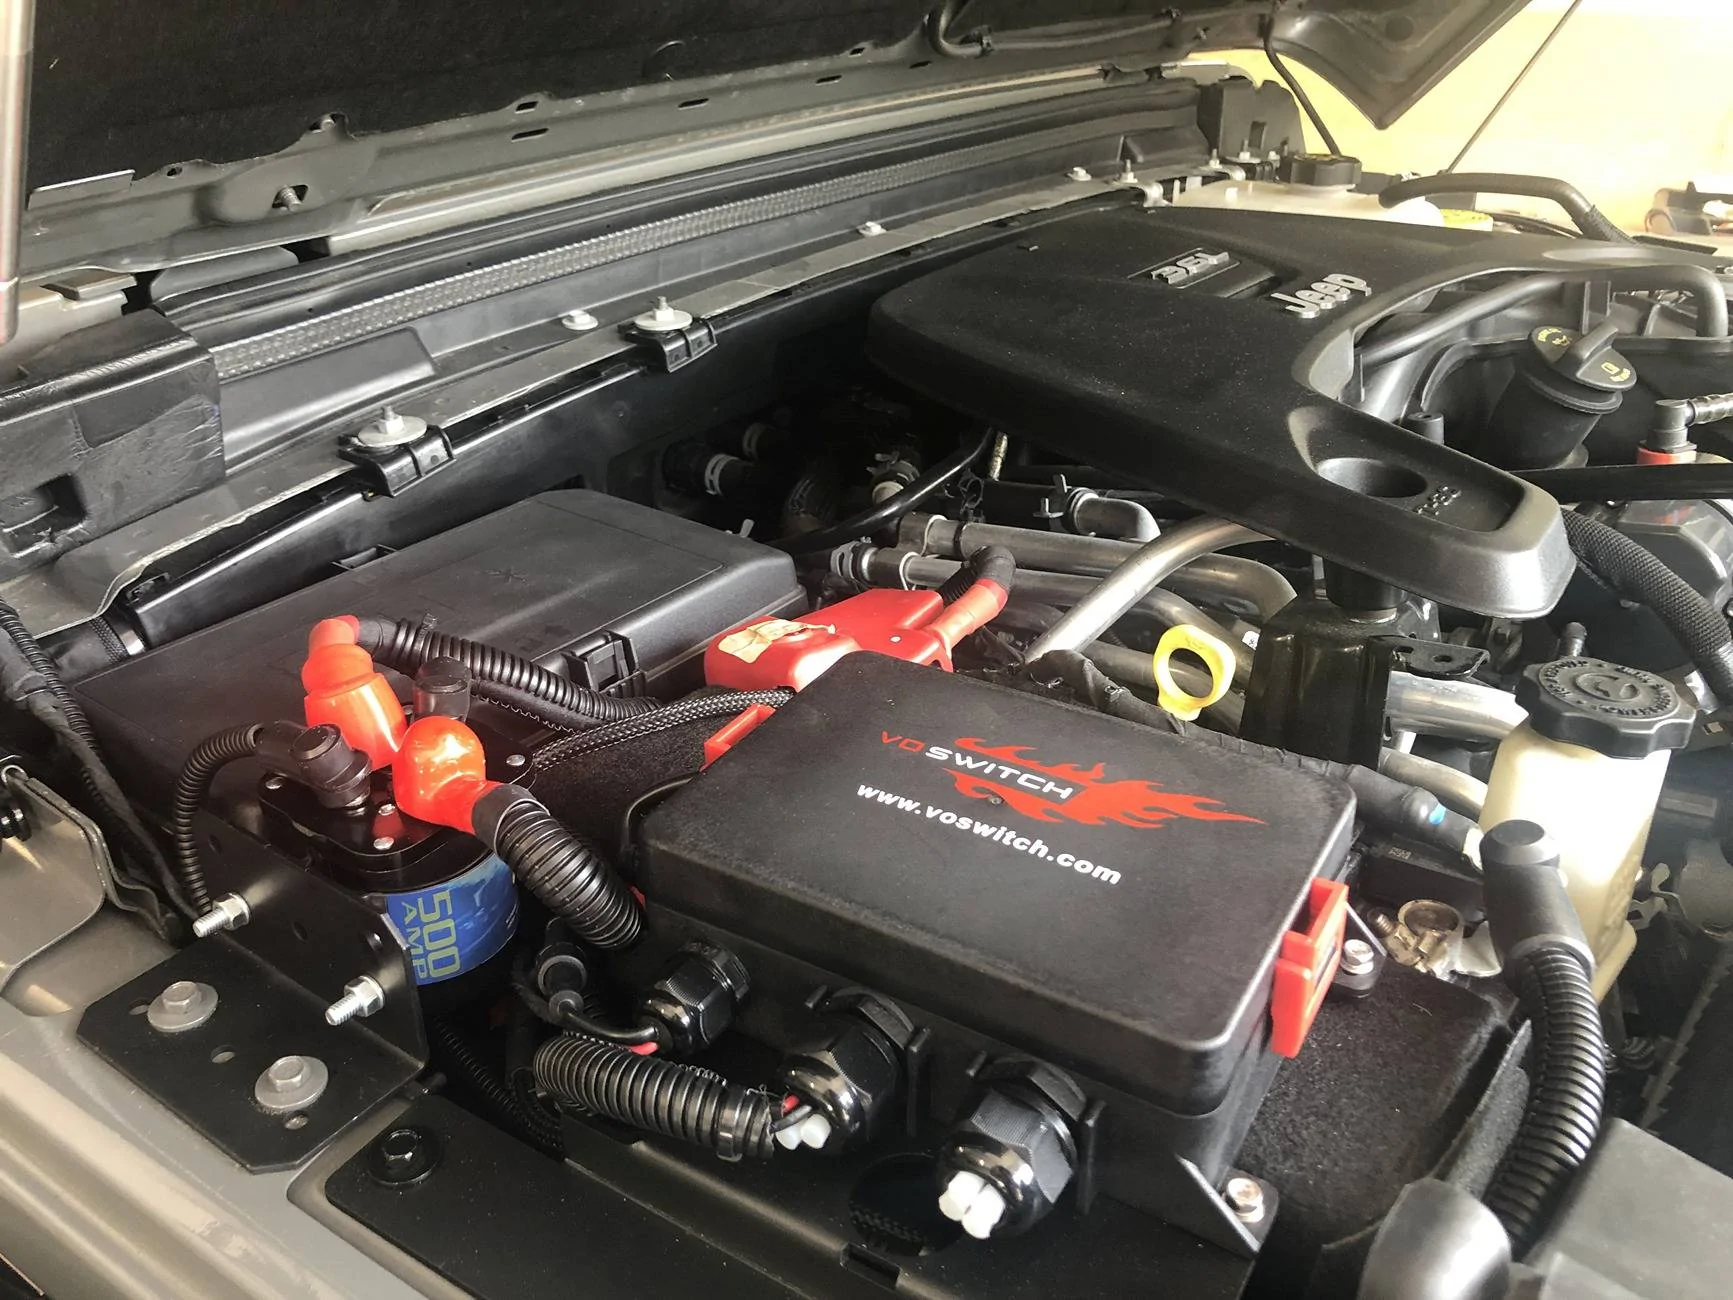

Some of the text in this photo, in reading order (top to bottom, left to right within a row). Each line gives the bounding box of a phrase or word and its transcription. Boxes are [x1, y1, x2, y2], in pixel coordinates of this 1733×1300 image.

[1271, 273, 1371, 318] Jeep
[857, 784, 1121, 885] www.voswitch.com
[401, 901, 428, 979] AMP
[418, 889, 460, 978] 500
